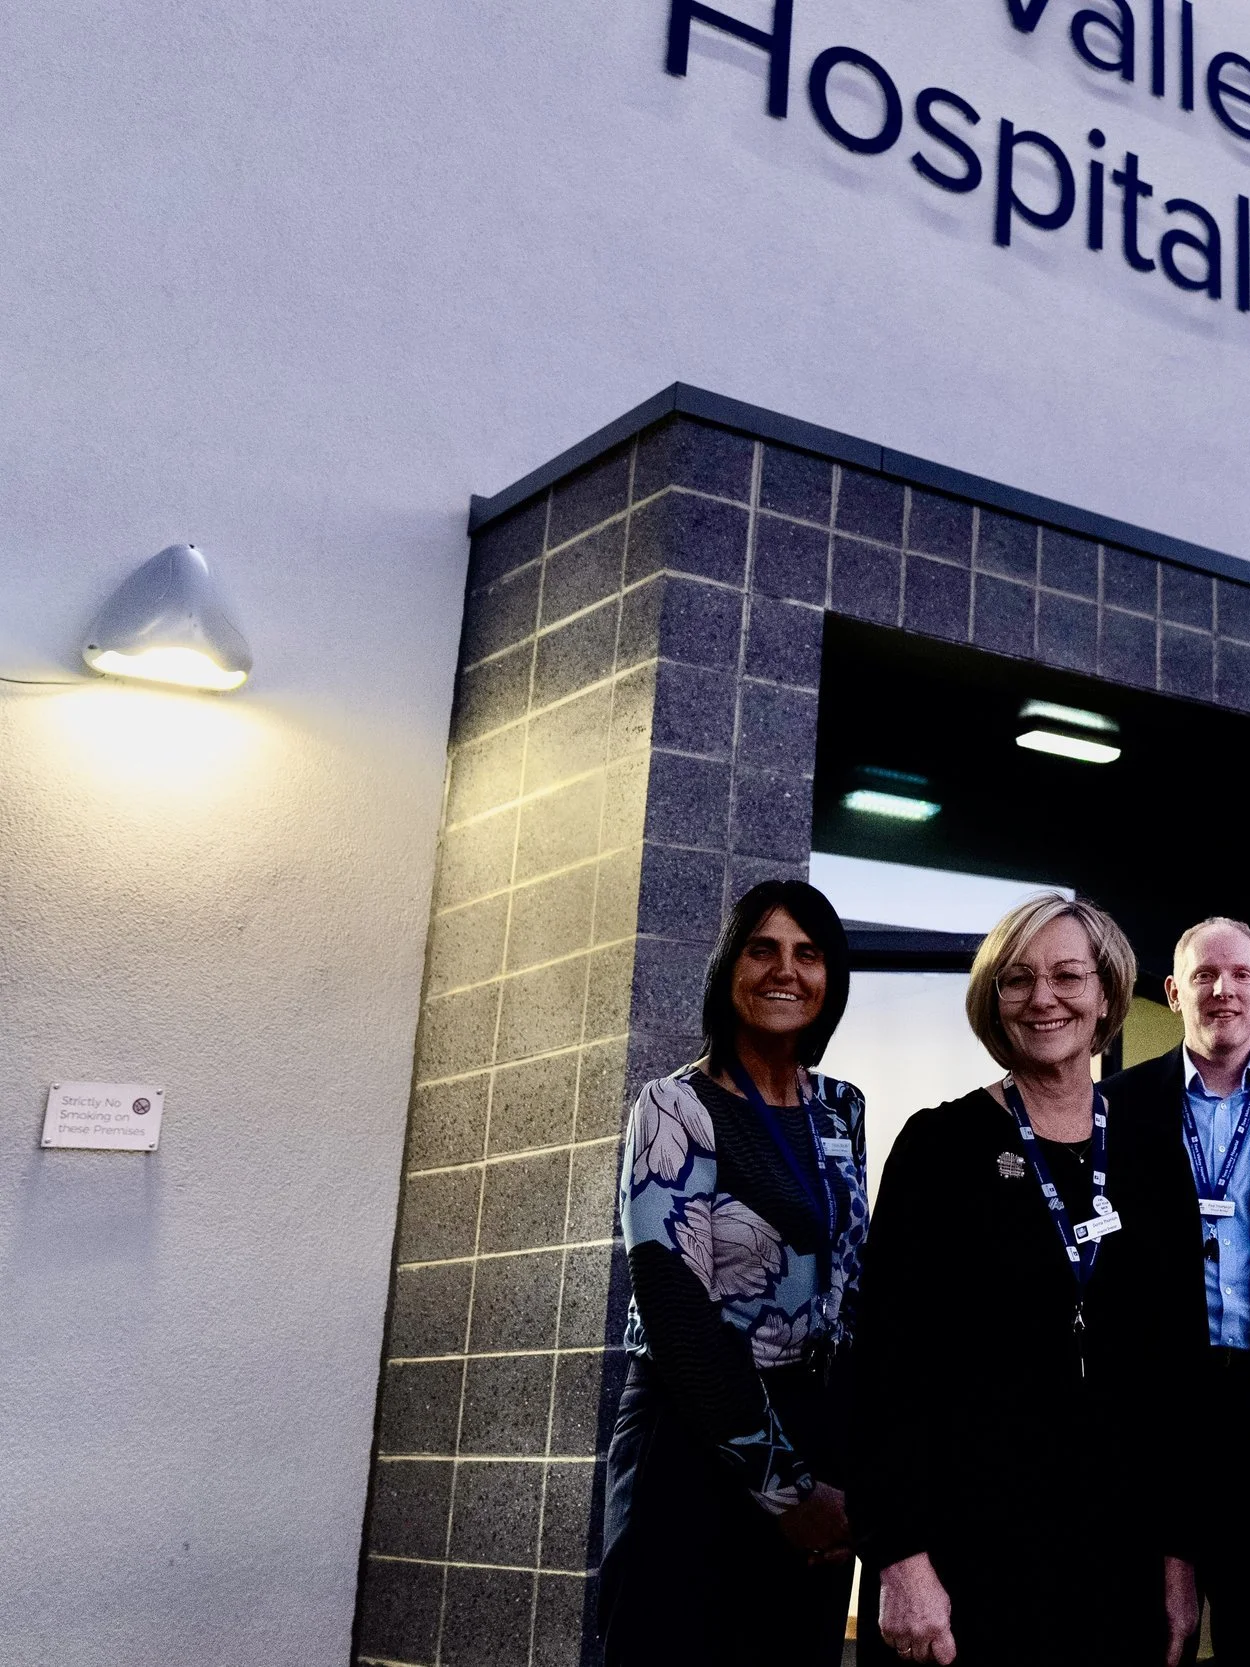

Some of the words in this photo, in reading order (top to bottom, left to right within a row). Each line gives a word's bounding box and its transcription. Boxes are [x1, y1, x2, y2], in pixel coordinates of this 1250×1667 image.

[665, 0, 1250, 312] Hospital
[61, 1095, 101, 1109] Strictly
[105, 1098, 122, 1108] No
[60, 1109, 112, 1123] Smoking
[115, 1114, 130, 1122] on
[58, 1124, 90, 1134] these
[93, 1124, 145, 1137] Premises
